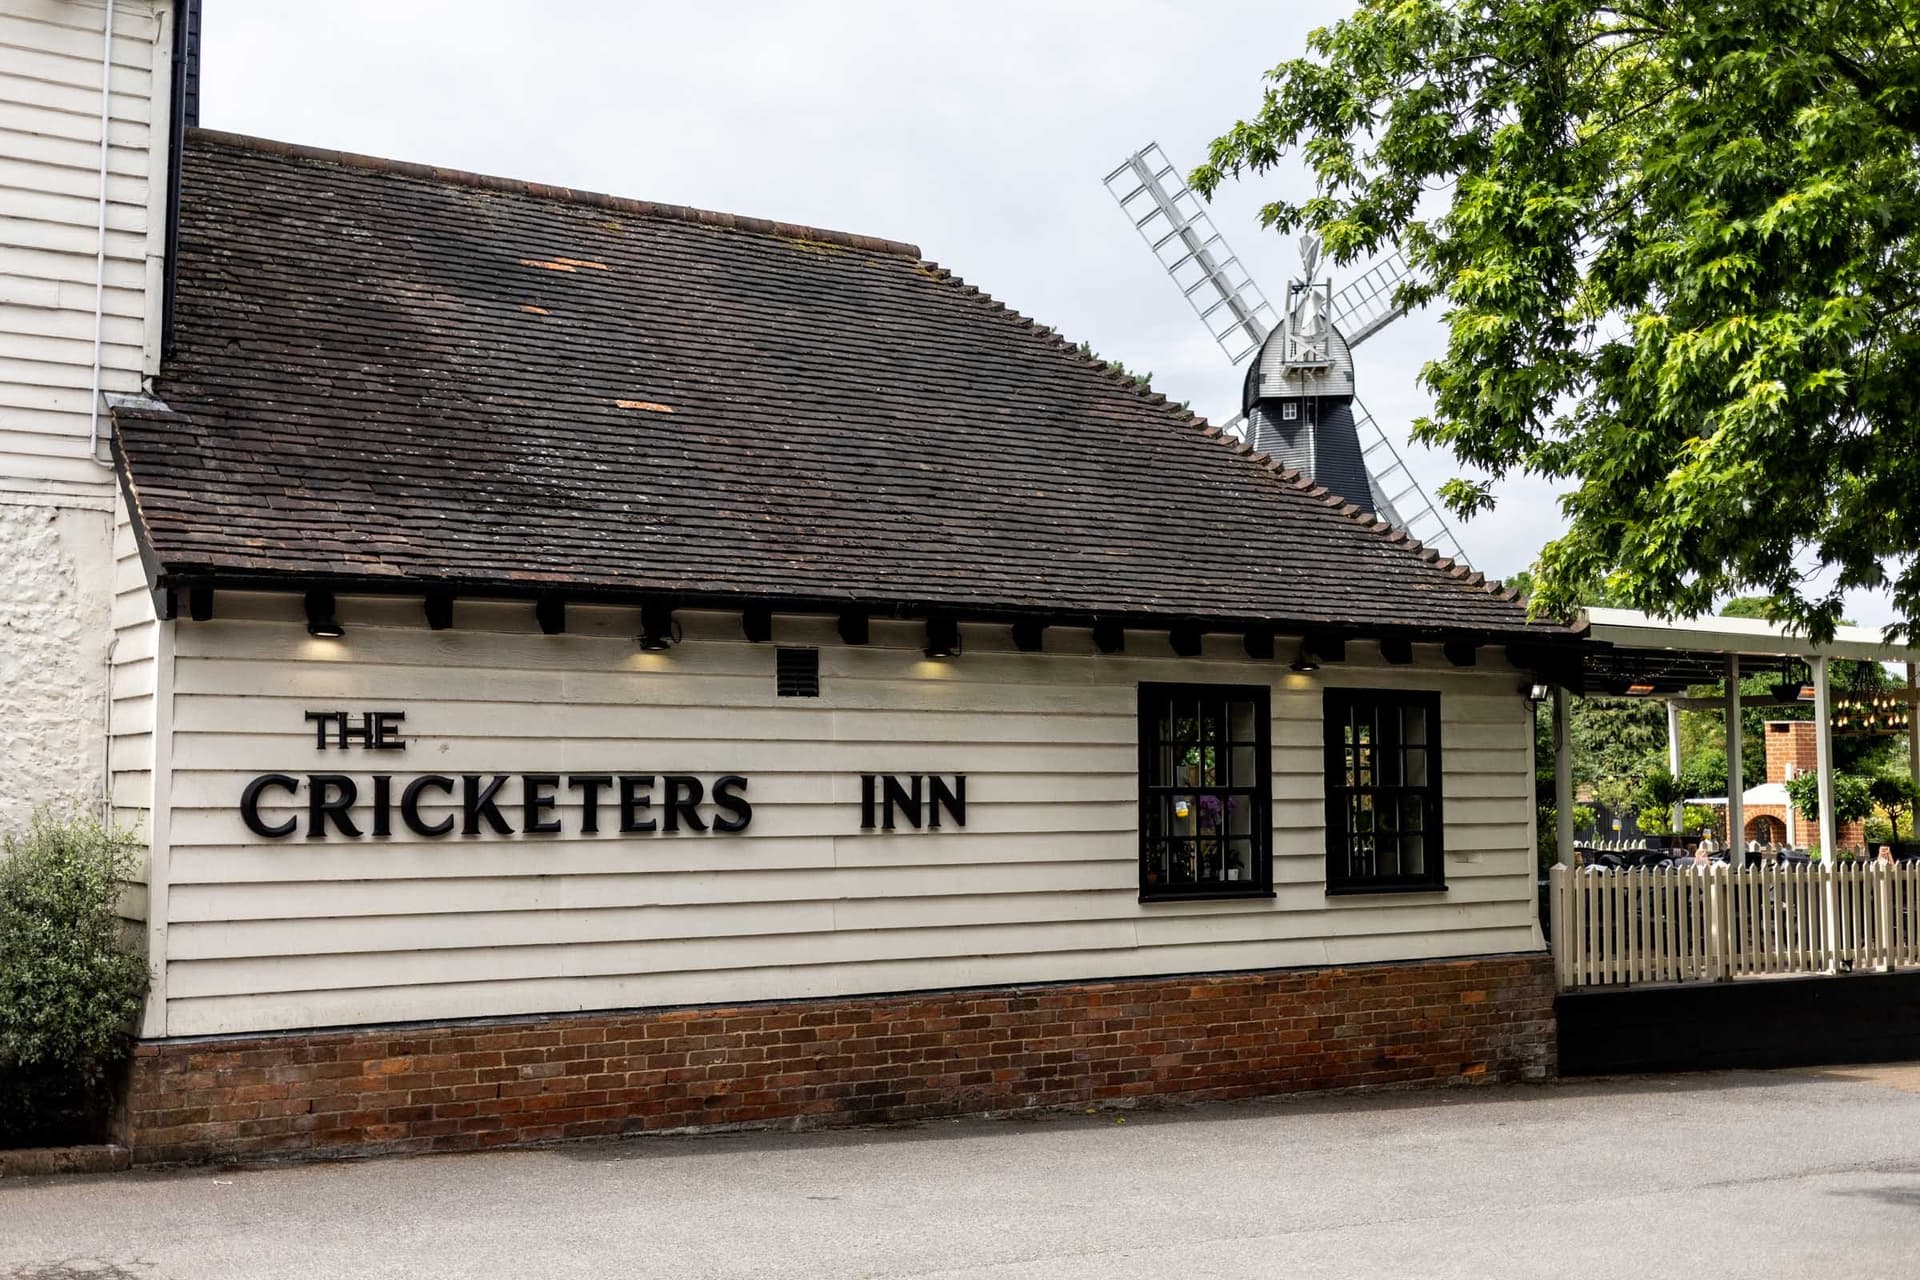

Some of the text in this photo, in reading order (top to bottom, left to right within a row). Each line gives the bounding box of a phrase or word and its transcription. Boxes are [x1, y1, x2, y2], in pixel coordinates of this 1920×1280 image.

[305, 710, 406, 750] THE
[240, 774, 967, 838] CRICKETERS INN
